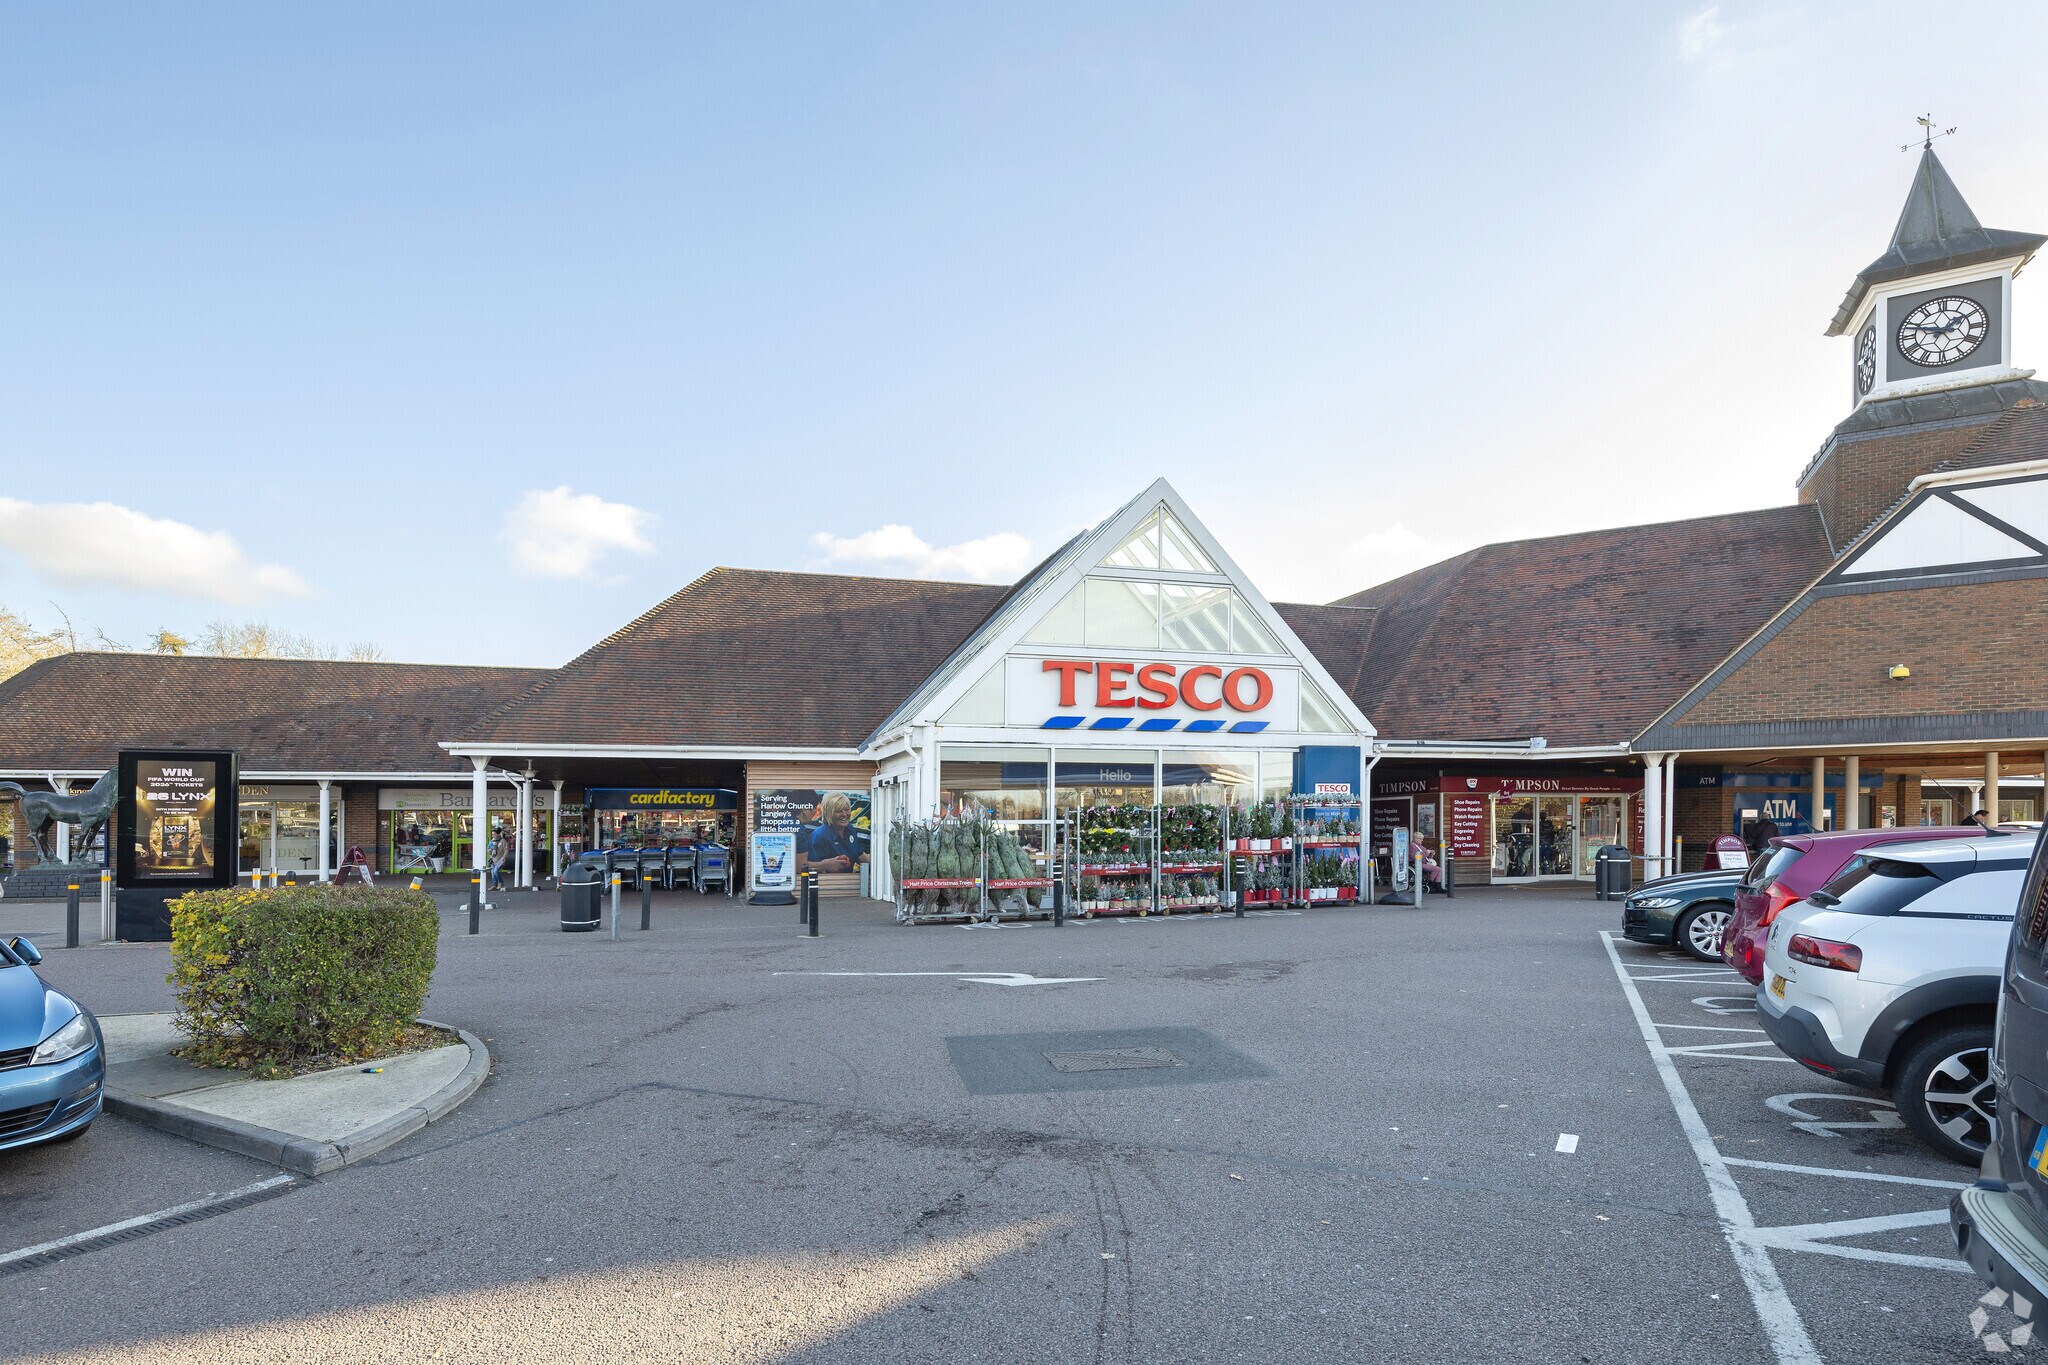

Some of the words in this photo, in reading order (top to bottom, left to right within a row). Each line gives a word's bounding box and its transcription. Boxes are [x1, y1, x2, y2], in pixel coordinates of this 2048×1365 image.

[1042, 660, 1274, 713] TESCO
[162, 768, 193, 777] WIN
[1100, 769, 1132, 782] Hello
[1501, 780, 1560, 790] TMPSON
[1700, 777, 1716, 785] ATM
[1318, 784, 1348, 792] TESCO
[1379, 780, 1426, 794] TIMPSON
[172, 792, 211, 800] LYNX
[629, 789, 716, 808] cardfactory
[760, 794, 788, 803] Serving
[760, 802, 786, 810] Harlow
[787, 802, 813, 810] Church
[1763, 800, 1796, 818] ATM
[760, 810, 792, 818] Langley's
[760, 818, 794, 826] shoppers
[1719, 838, 1741, 846] TIMPSON
